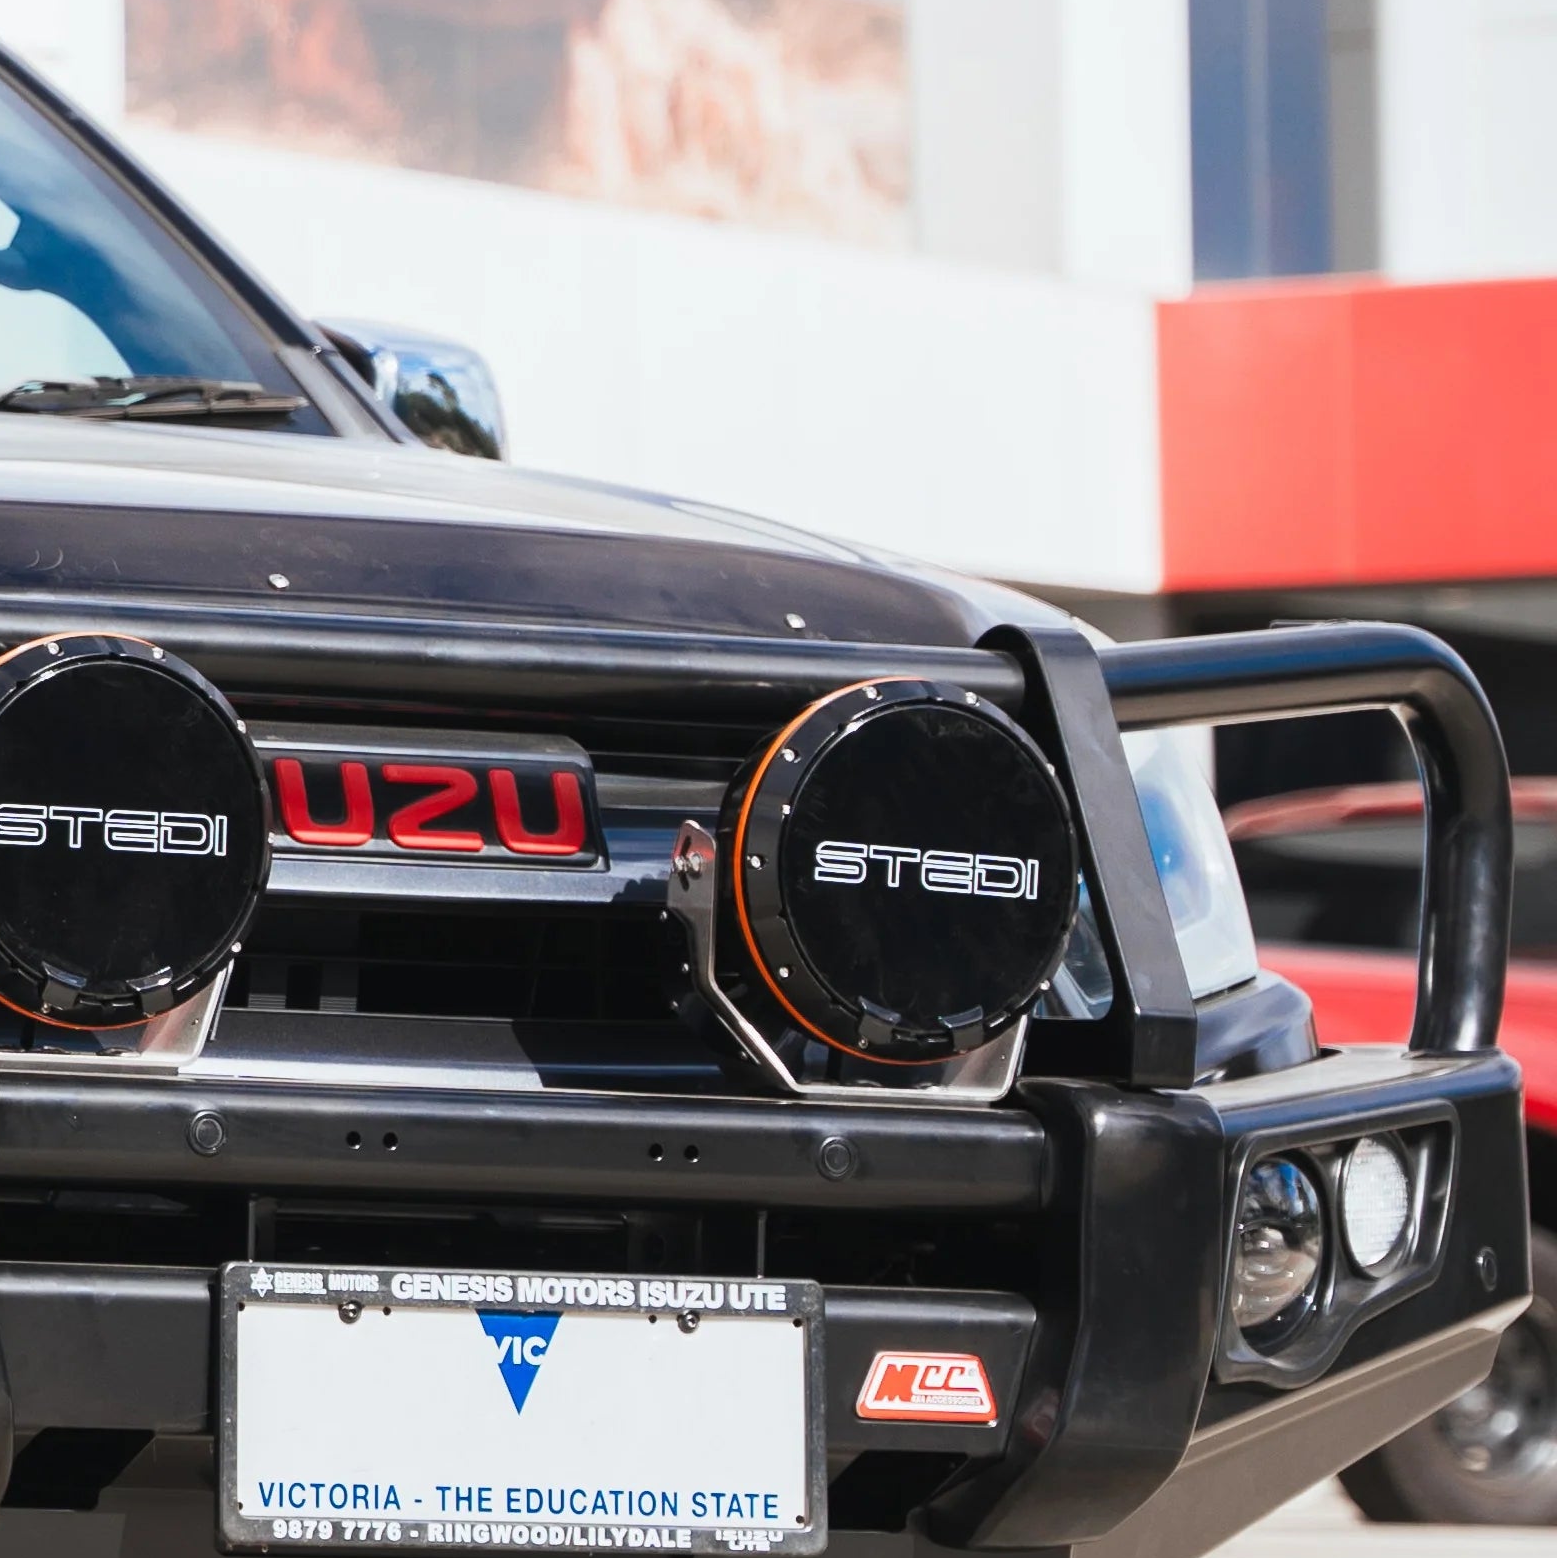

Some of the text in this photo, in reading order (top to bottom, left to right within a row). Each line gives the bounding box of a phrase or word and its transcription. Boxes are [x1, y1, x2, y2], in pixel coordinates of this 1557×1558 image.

[274, 757, 585, 855] UZU
[814, 840, 1039, 899] STEDI
[274, 1272, 379, 1292] GENESIS MOTORS
[390, 1273, 787, 1311] GENESIS MOTORS ISUZU UTE
[485, 1335, 547, 1366] VIC
[874, 1363, 980, 1402] MCC
[258, 1482, 401, 1511] VICTORIA
[436, 1485, 493, 1513] THE
[506, 1488, 678, 1517] EDUCATION
[692, 1492, 779, 1519] STATE
[272, 1519, 333, 1540] 9879
[341, 1520, 402, 1542] 7776
[427, 1522, 692, 1549] RINGWOOD/LILYDALE
[715, 1529, 784, 1543] ISUZU
